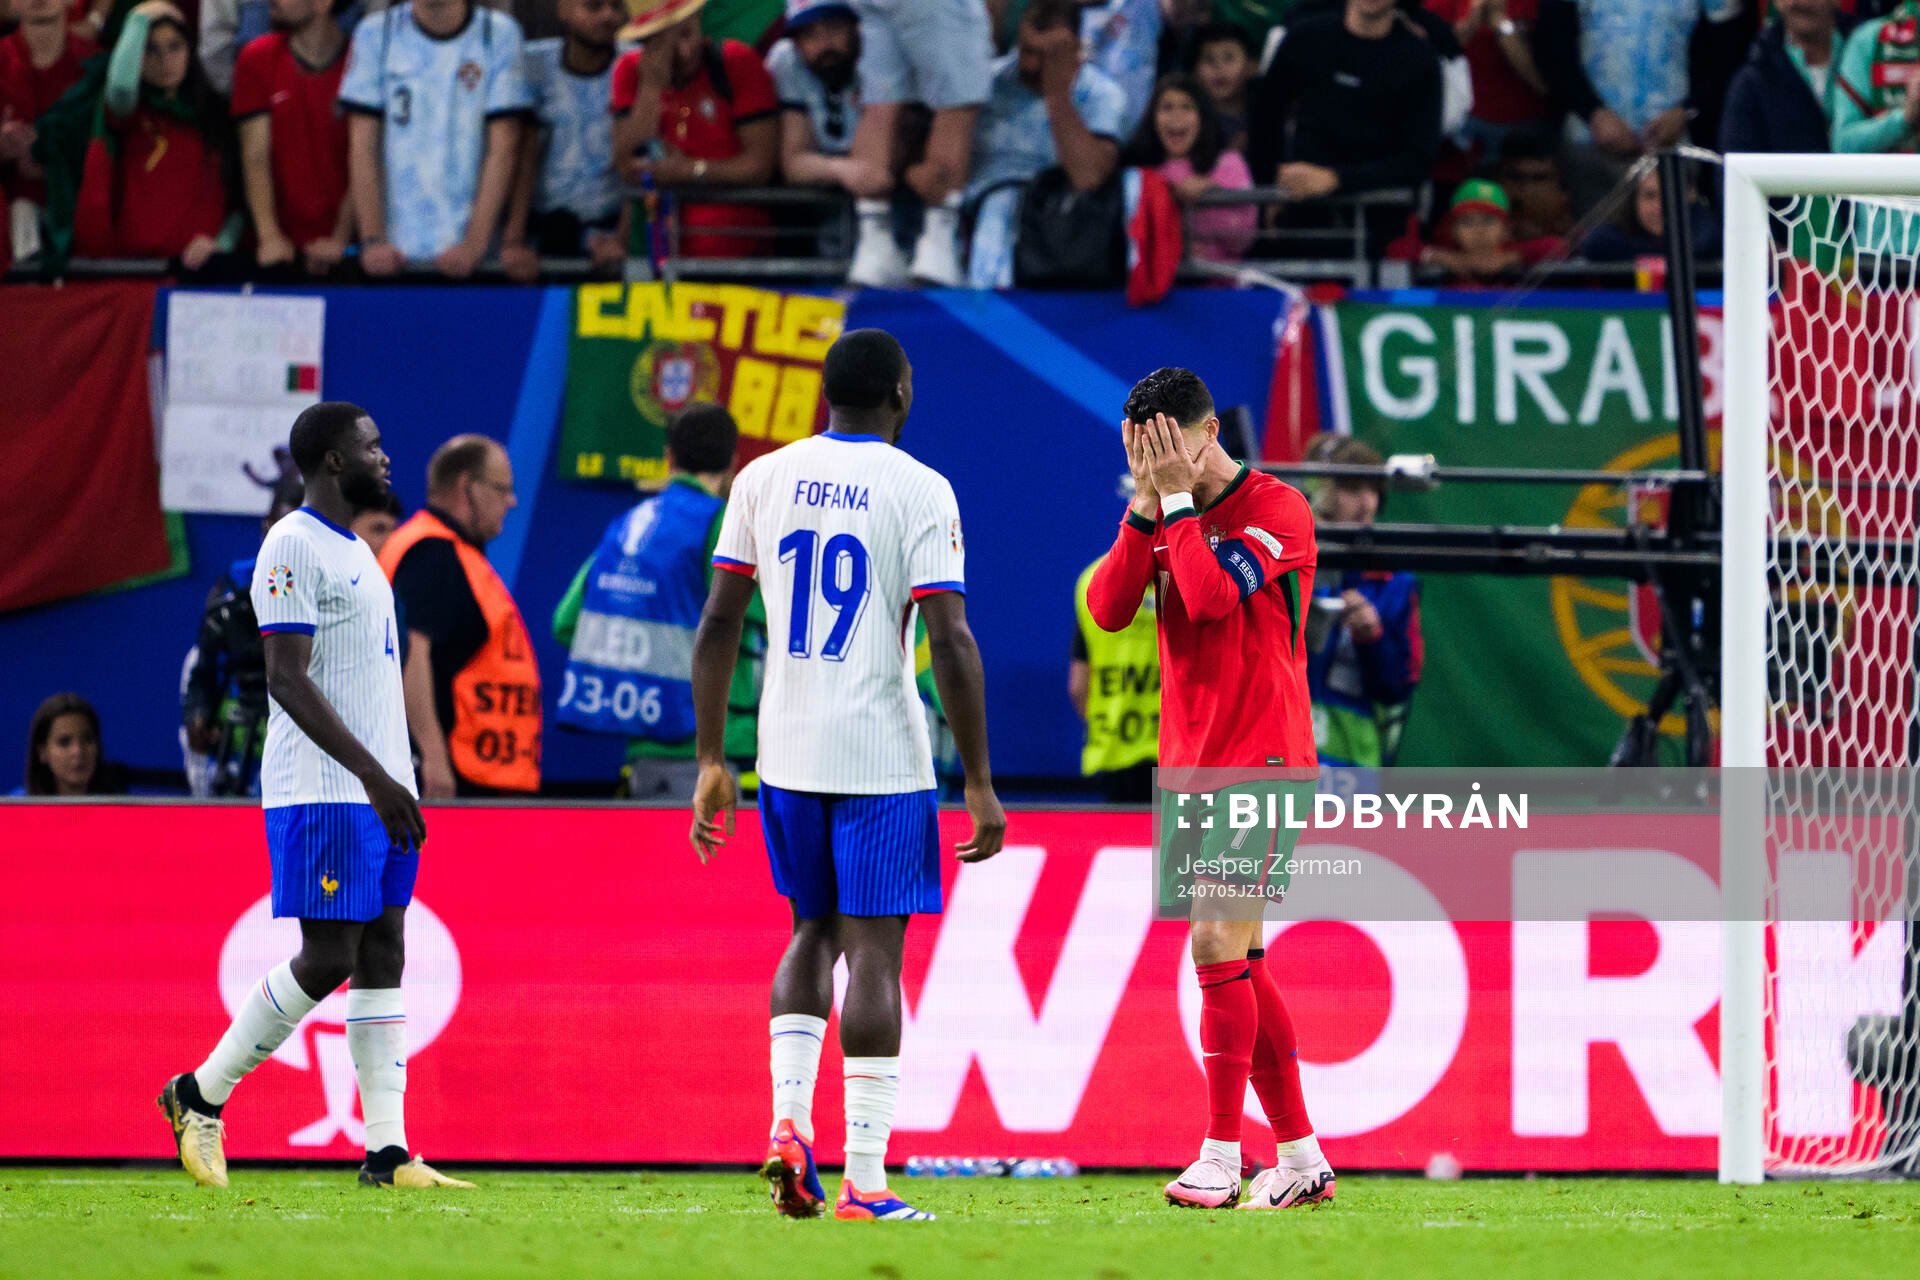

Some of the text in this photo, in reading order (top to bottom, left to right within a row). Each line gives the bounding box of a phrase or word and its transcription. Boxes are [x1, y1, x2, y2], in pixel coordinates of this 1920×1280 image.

[794, 480, 869, 511] FOFANA
[384, 616, 396, 662] 4
[779, 529, 872, 662] 19
[832, 845, 1906, 1138] WORK
